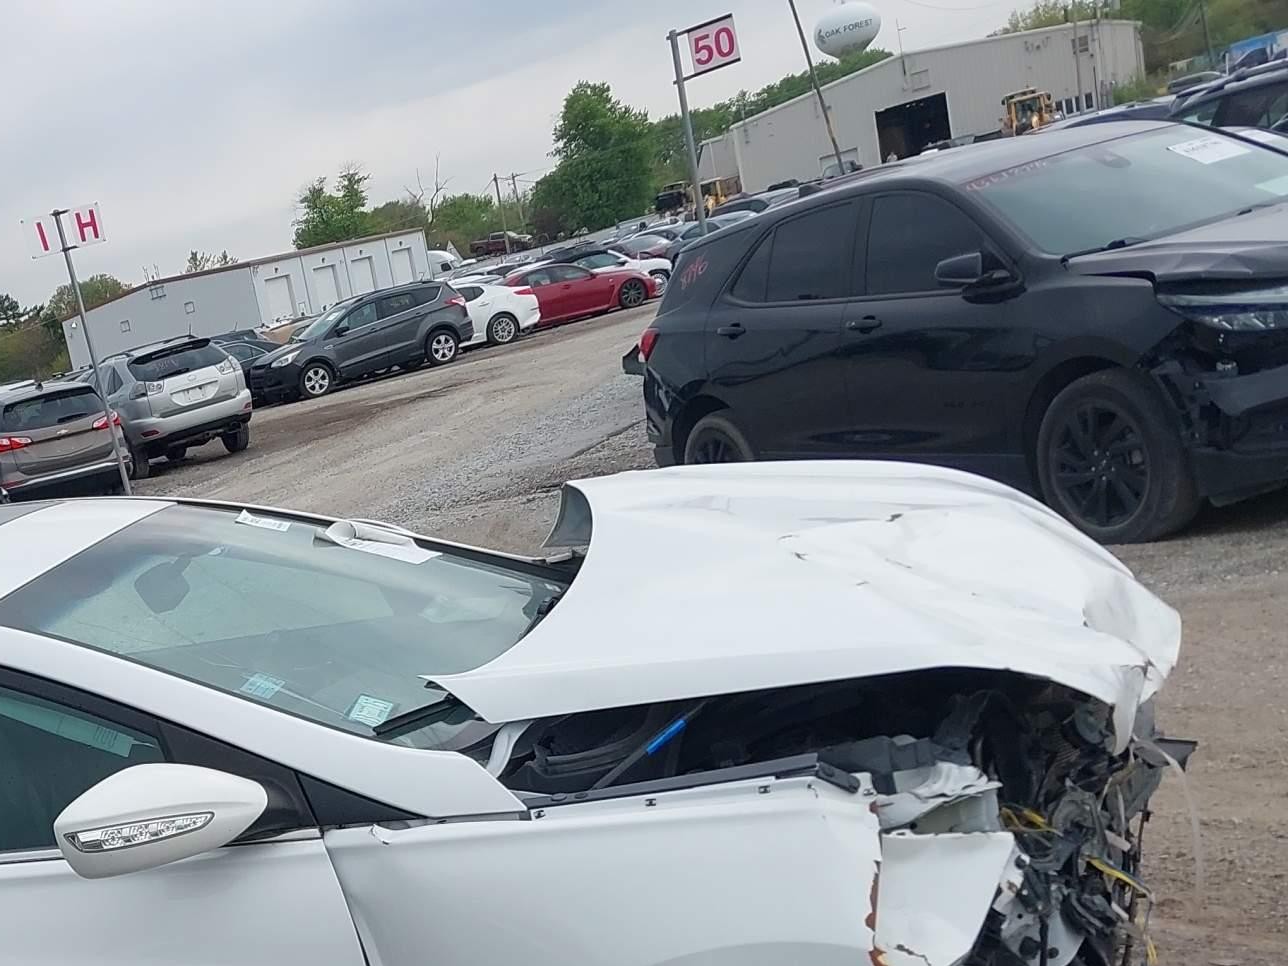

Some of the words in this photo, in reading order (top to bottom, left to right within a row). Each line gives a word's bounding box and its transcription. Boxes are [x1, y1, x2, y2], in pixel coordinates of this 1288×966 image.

[824, 27, 841, 39] OAK
[843, 18, 873, 33] FOREST
[694, 27, 735, 65] 50
[75, 208, 99, 242] H
